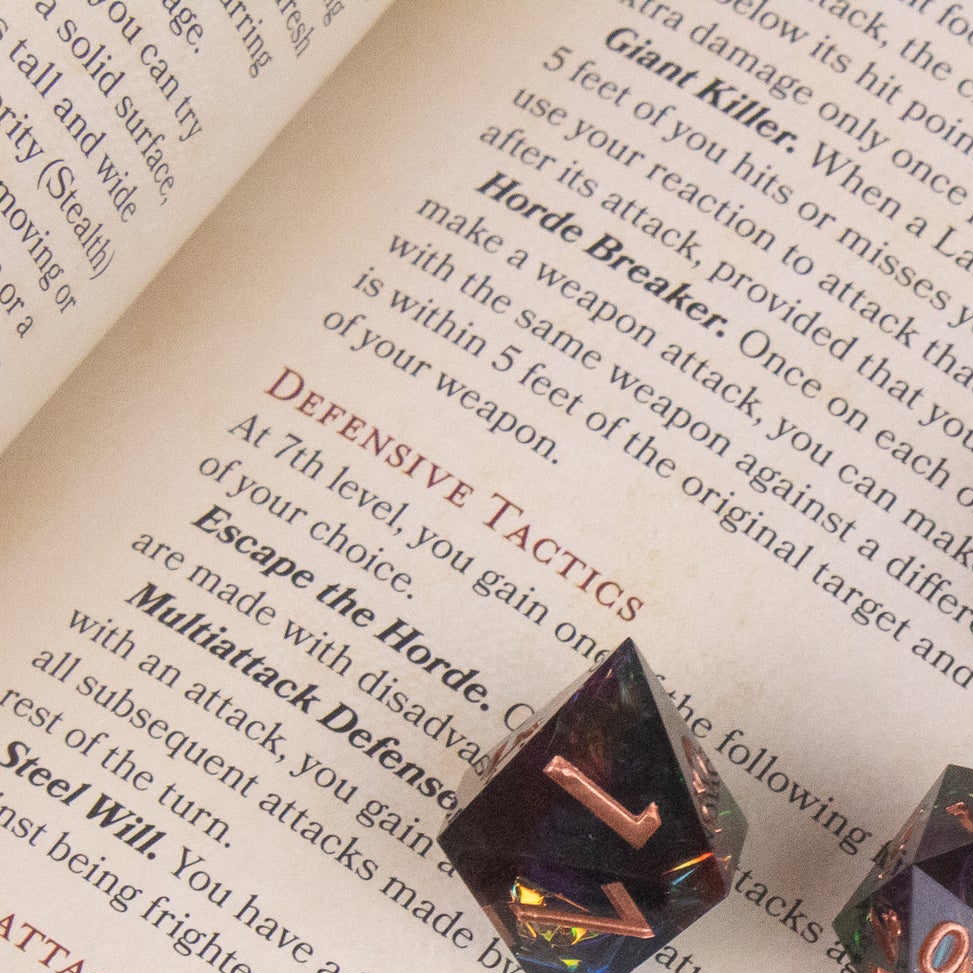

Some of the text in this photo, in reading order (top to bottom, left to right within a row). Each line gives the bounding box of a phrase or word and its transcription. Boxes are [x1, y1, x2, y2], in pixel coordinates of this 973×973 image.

[55, 18, 175, 206] solid surface,
[139, 42, 203, 143] can try
[603, 25, 700, 90] Giant
[692, 76, 799, 154] Killer.
[810, 140, 902, 220] When
[688, 21, 814, 105] damage
[35, 157, 116, 281] (Stealth)
[95, 152, 139, 223] wide
[474, 170, 951, 490] Horde Breaker. Once each
[599, 192, 860, 362] attack, provided
[535, 261, 762, 427] weapon attack,
[262, 365, 645, 622] DEFENSIVE TACTICS
[389, 288, 487, 358] within
[680, 475, 815, 571] original
[810, 561, 911, 642] target
[733, 452, 857, 543] against
[224, 473, 413, 600] your choice.
[273, 431, 549, 627] 7th level, gain
[123, 580, 322, 715] Multiattack
[190, 502, 490, 712] Escape the Horde.
[0, 739, 93, 807] Steel
[84, 791, 168, 861] Will.
[74, 674, 259, 799] subsequent
[156, 781, 231, 849] turn.
[542, 755, 662, 850] 1
[46, 830, 144, 913] being
